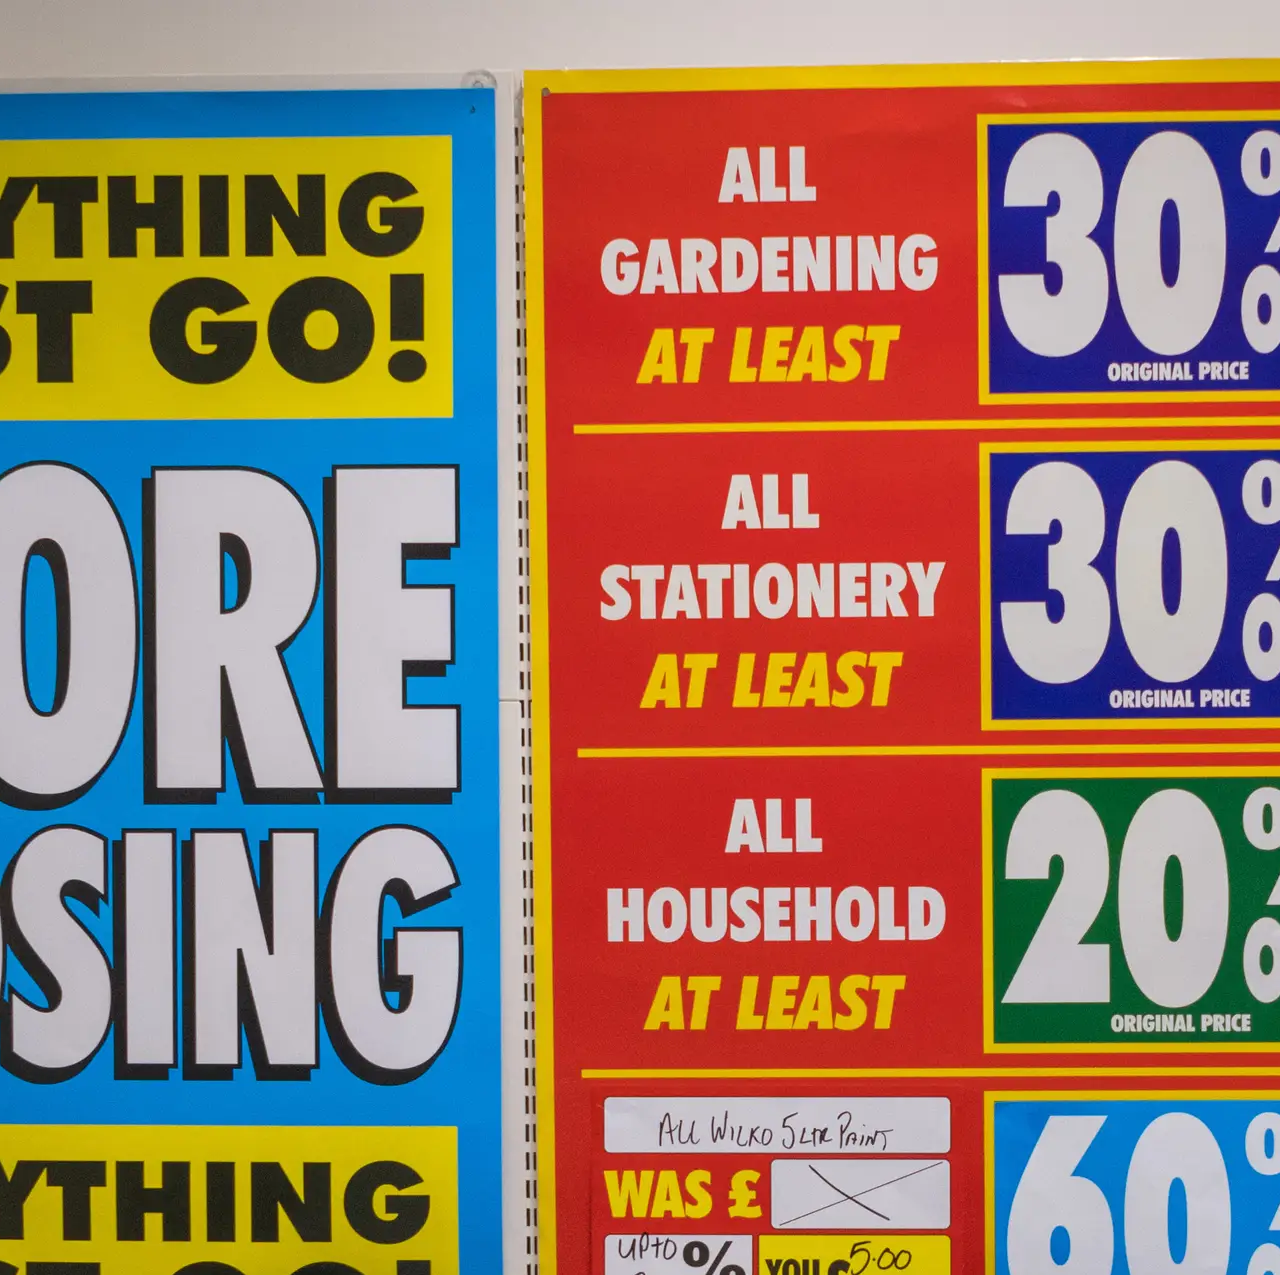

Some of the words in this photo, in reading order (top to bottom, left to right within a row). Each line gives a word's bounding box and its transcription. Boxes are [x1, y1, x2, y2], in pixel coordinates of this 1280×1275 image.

[718, 146, 816, 204] ALL
[600, 233, 938, 295] GARDENING
[149, 273, 428, 385] GO!
[636, 328, 716, 384] AT
[728, 324, 901, 384] LEAST
[1107, 362, 1193, 382] ORIGINAL
[1198, 360, 1250, 381] PRICE
[721, 473, 820, 531] ALL
[600, 561, 946, 621] STATIONERY
[640, 654, 717, 709] AT
[731, 651, 903, 708] LEAST
[1109, 690, 1194, 708] ORIGINAL
[1199, 689, 1251, 708] PRICE
[725, 797, 823, 854] ALL
[606, 886, 946, 943] HOUSEHOLD
[644, 976, 721, 1031] AT
[736, 975, 906, 1031] LEAST
[1110, 1014, 1195, 1034] ORIGINAL
[1201, 1013, 1252, 1033] PRICE
[659, 1112, 700, 1146] ALL
[711, 1110, 773, 1147] WILKO
[837, 1111, 894, 1150] PAINT
[604, 1169, 713, 1219] WAS
[728, 1169, 762, 1218] £
